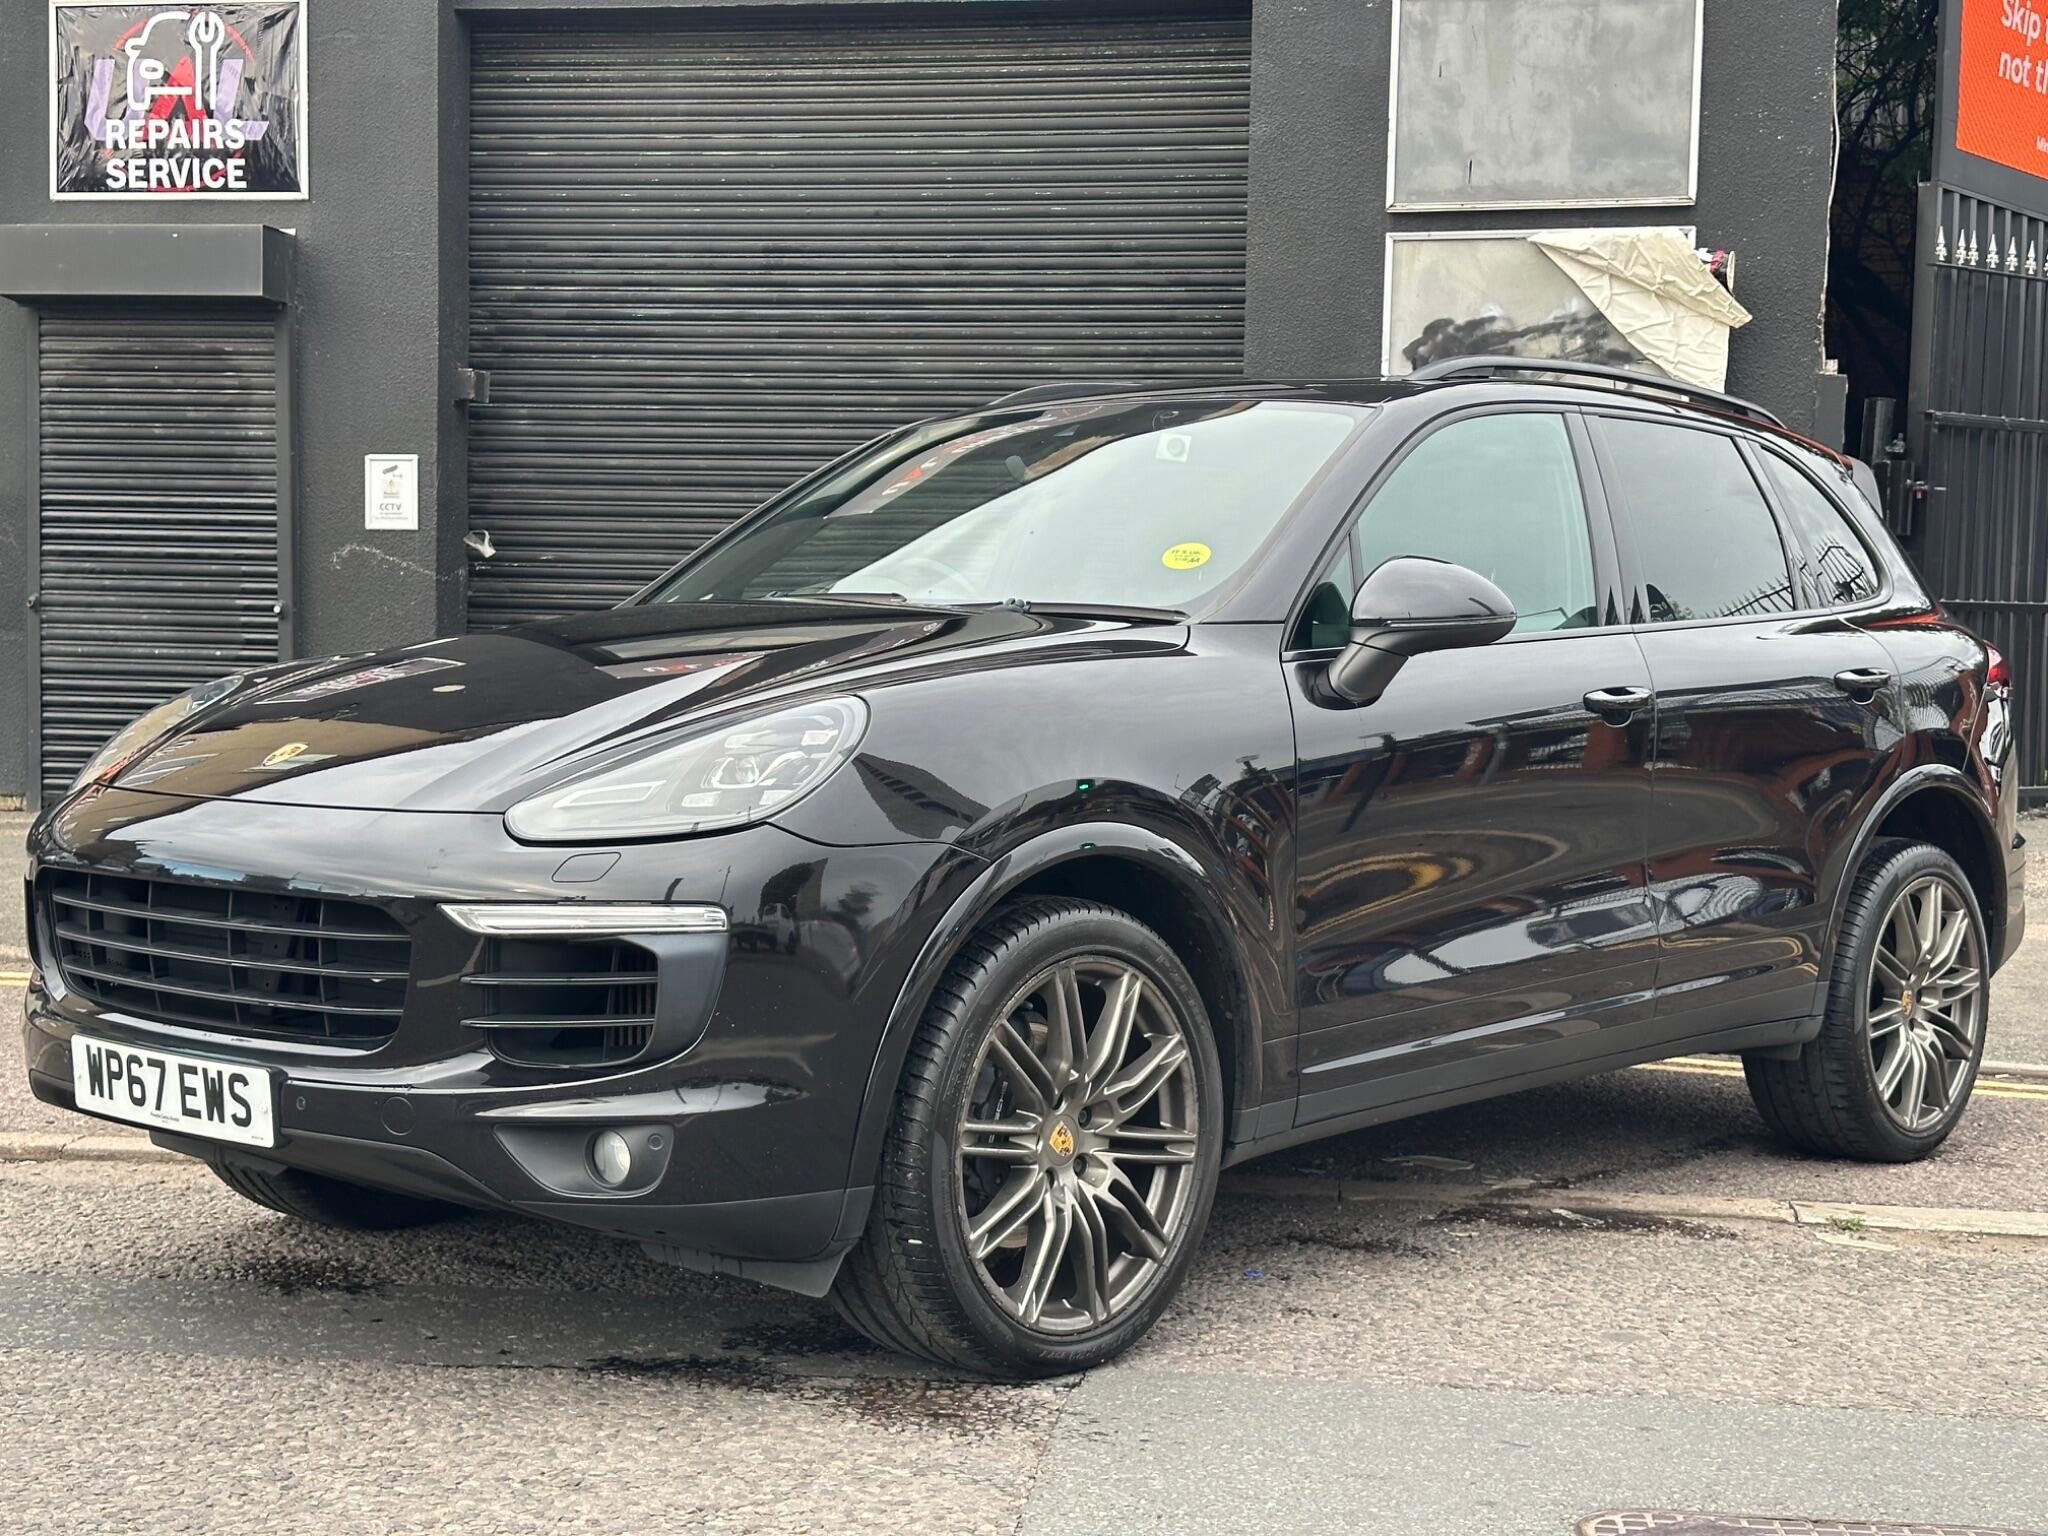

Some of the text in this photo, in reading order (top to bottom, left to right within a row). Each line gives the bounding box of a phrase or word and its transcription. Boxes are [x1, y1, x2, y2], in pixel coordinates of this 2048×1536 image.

[2000, 0, 2041, 46] Skip
[1998, 51, 2032, 88] not
[105, 119, 246, 150] REPAIRS
[105, 157, 247, 189] SERVICE
[379, 503, 402, 511] CCTV
[85, 1044, 252, 1128] WP67 EWS
